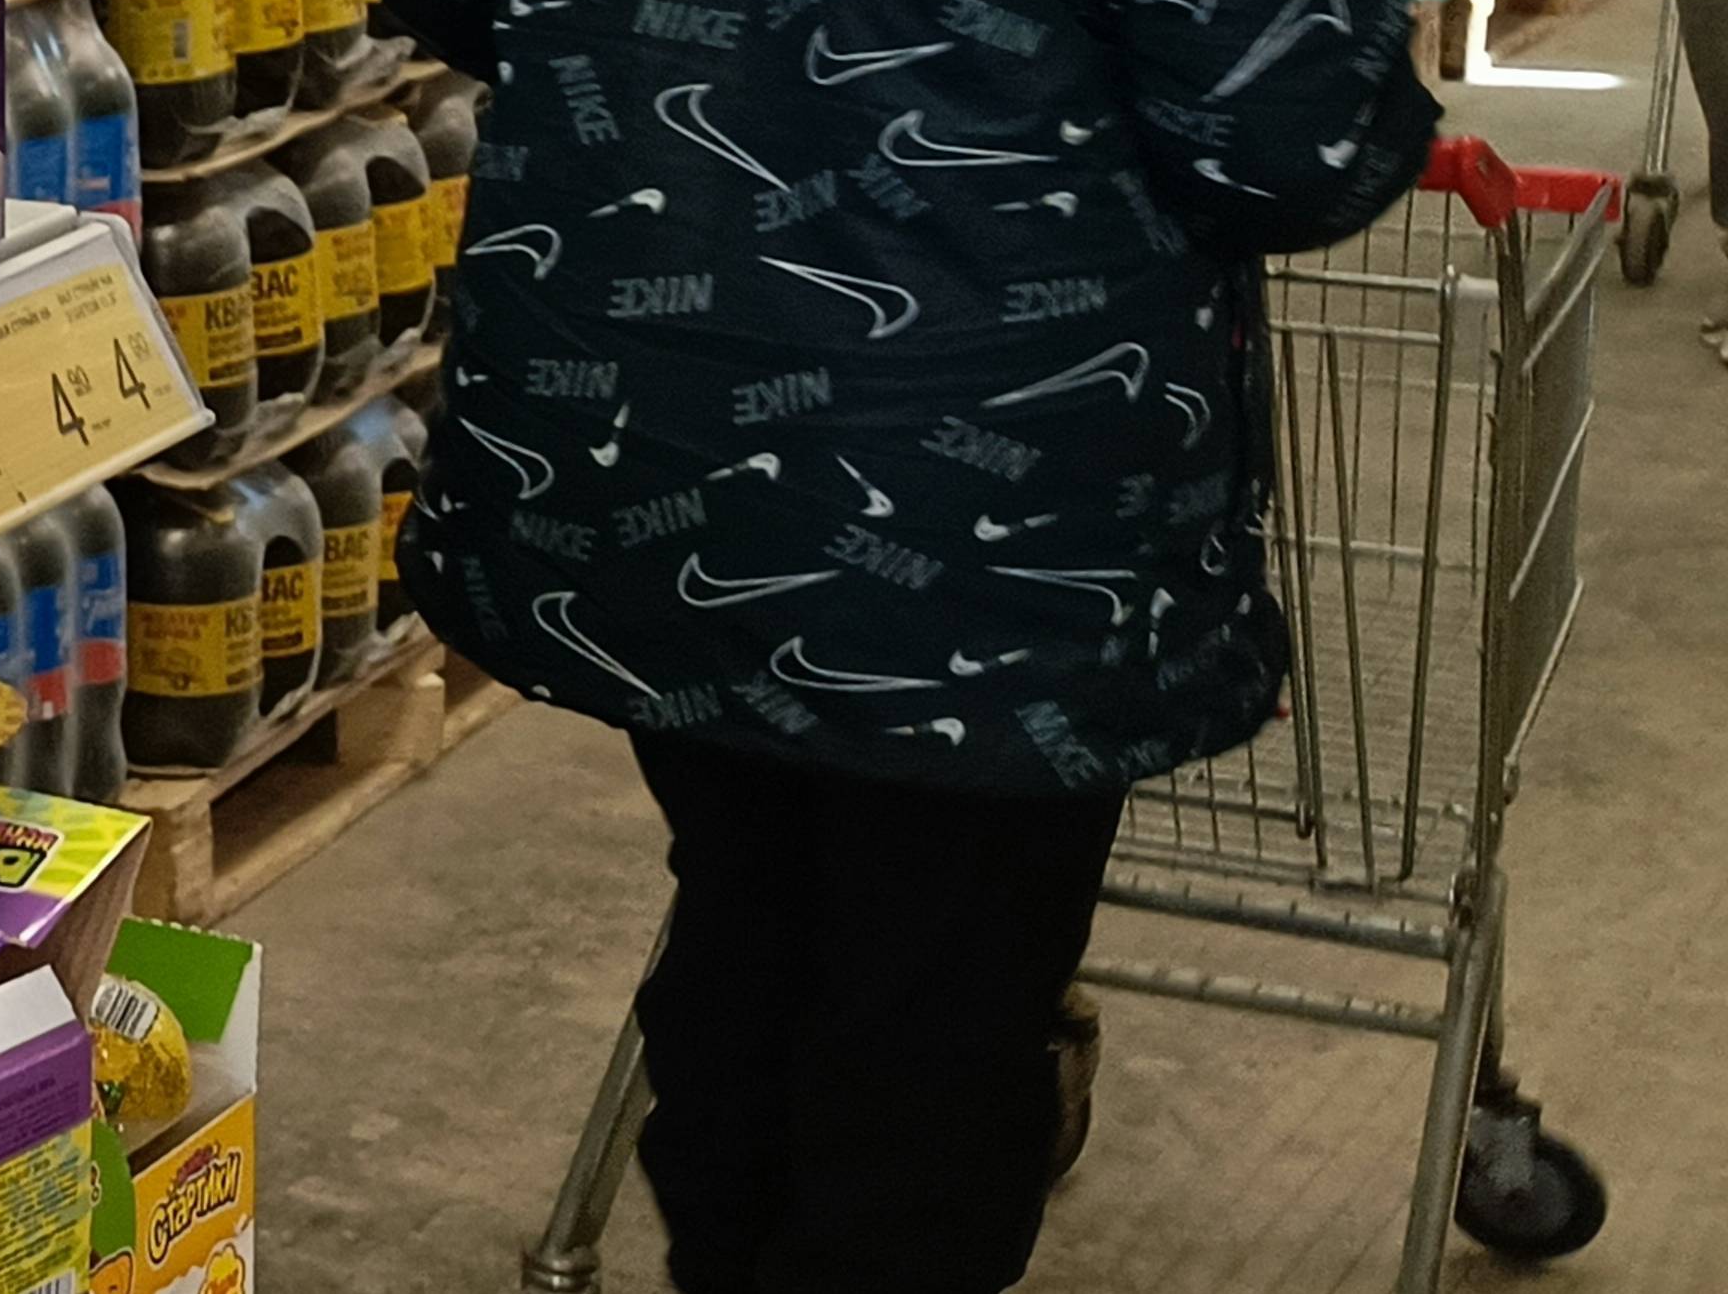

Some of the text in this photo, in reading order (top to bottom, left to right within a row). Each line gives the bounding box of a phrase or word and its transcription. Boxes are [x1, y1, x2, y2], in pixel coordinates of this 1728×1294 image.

[609, 272, 714, 319] NIKE
[51, 372, 90, 447] 4
[113, 337, 152, 410] 4
